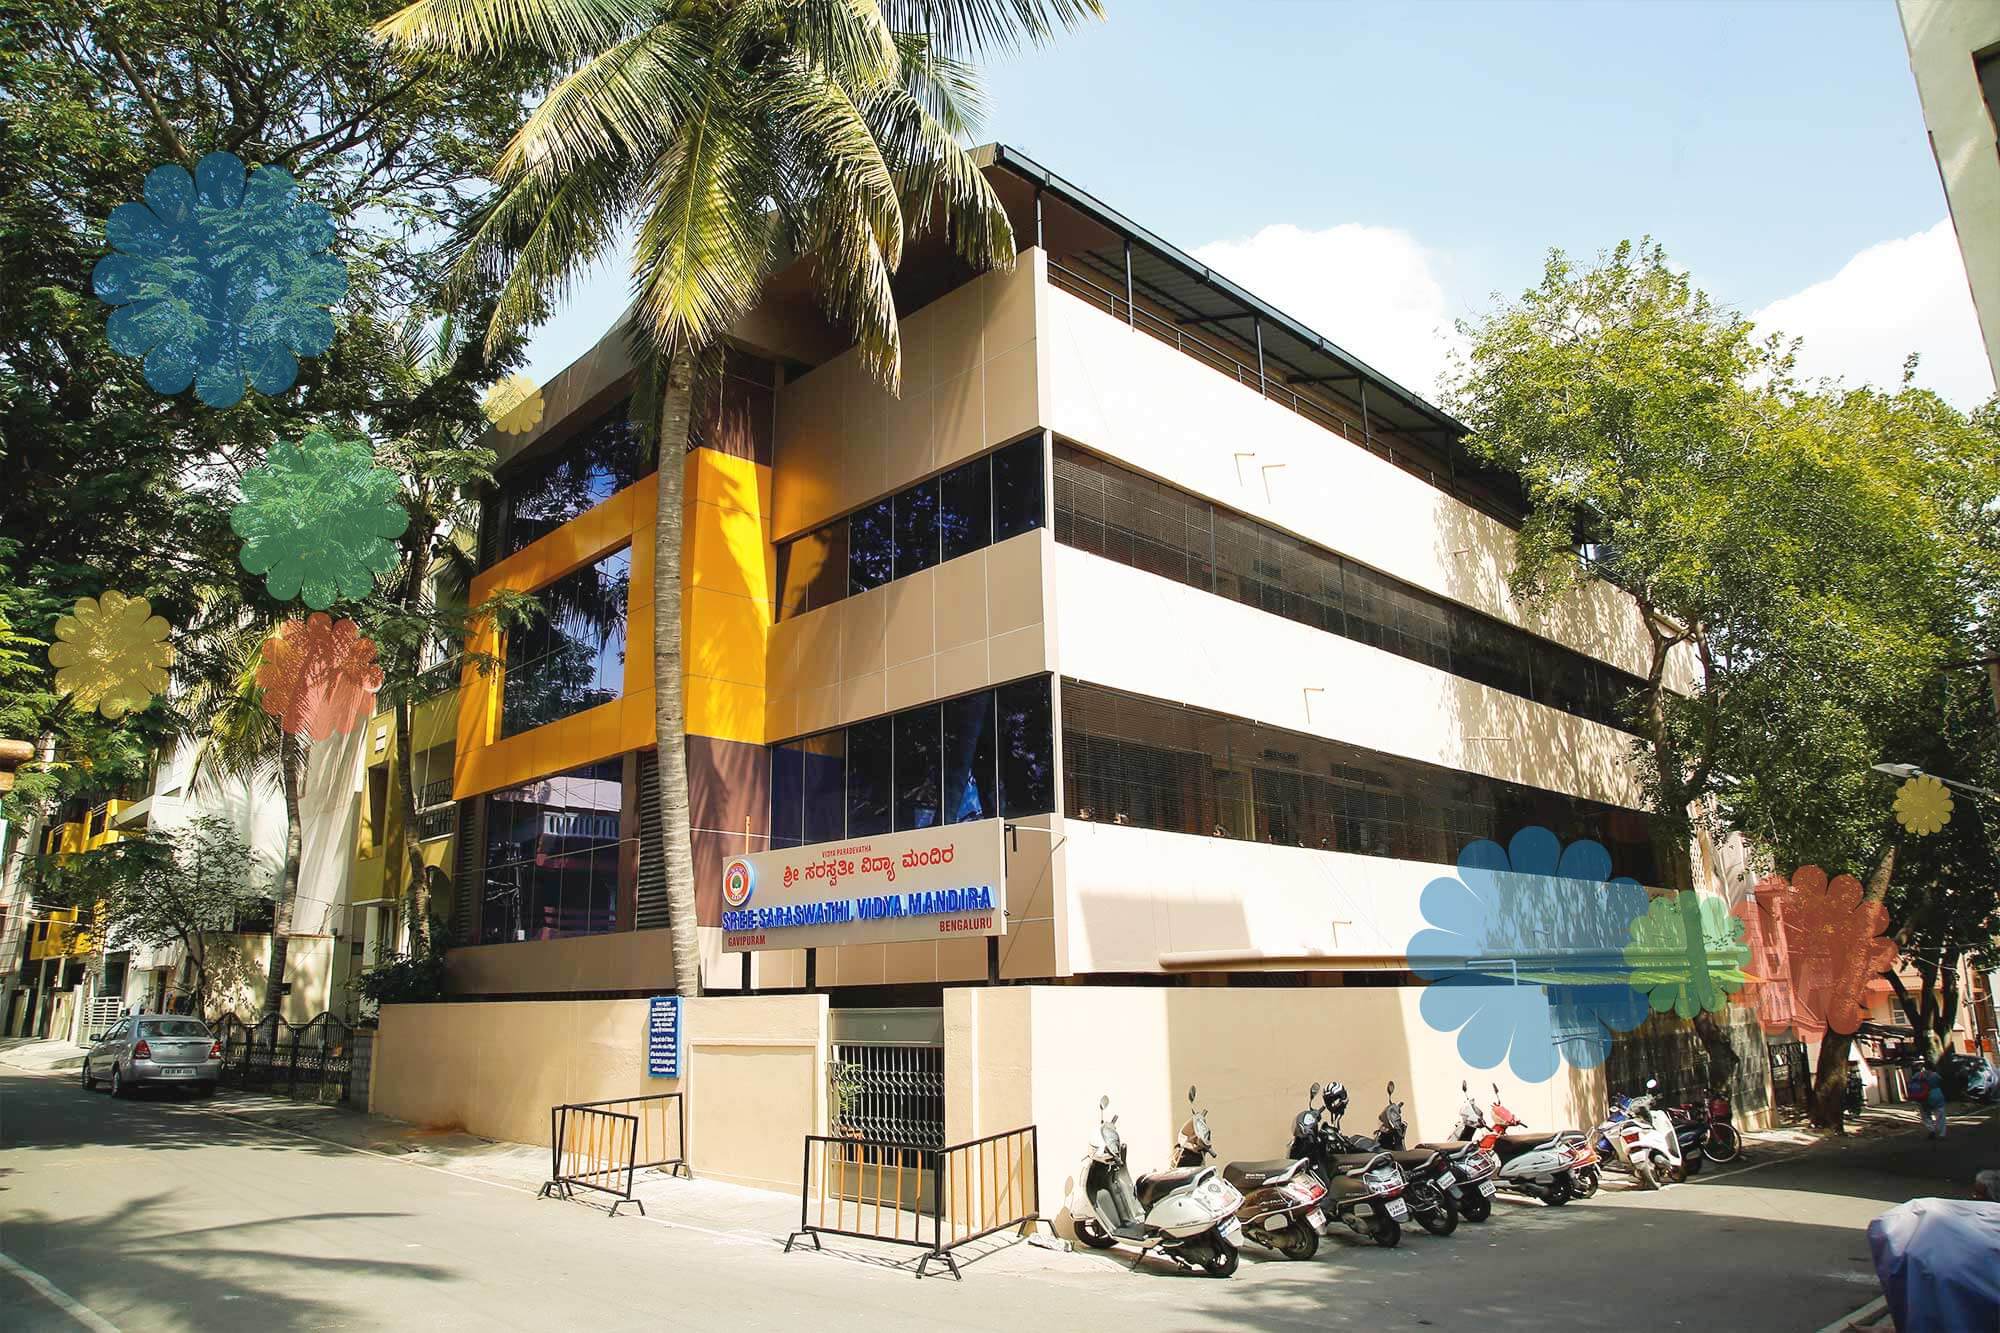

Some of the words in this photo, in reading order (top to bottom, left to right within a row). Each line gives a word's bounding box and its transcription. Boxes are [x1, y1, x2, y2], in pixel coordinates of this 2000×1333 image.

[783, 864, 799, 888] ಶ್ರೀ
[805, 859, 855, 887] ಸರಸ್ವತೀ
[861, 856, 896, 882] ವಿದ್ಯಾ
[902, 844, 954, 868] ಮಂದಿರ
[722, 910, 758, 932] SREE
[759, 898, 852, 930] SARASWATHI
[856, 895, 905, 920] VIDYA
[908, 885, 995, 917] MANDIRA
[939, 917, 993, 932] BENGALURU
[727, 935, 766, 947] GAVIPURAM
